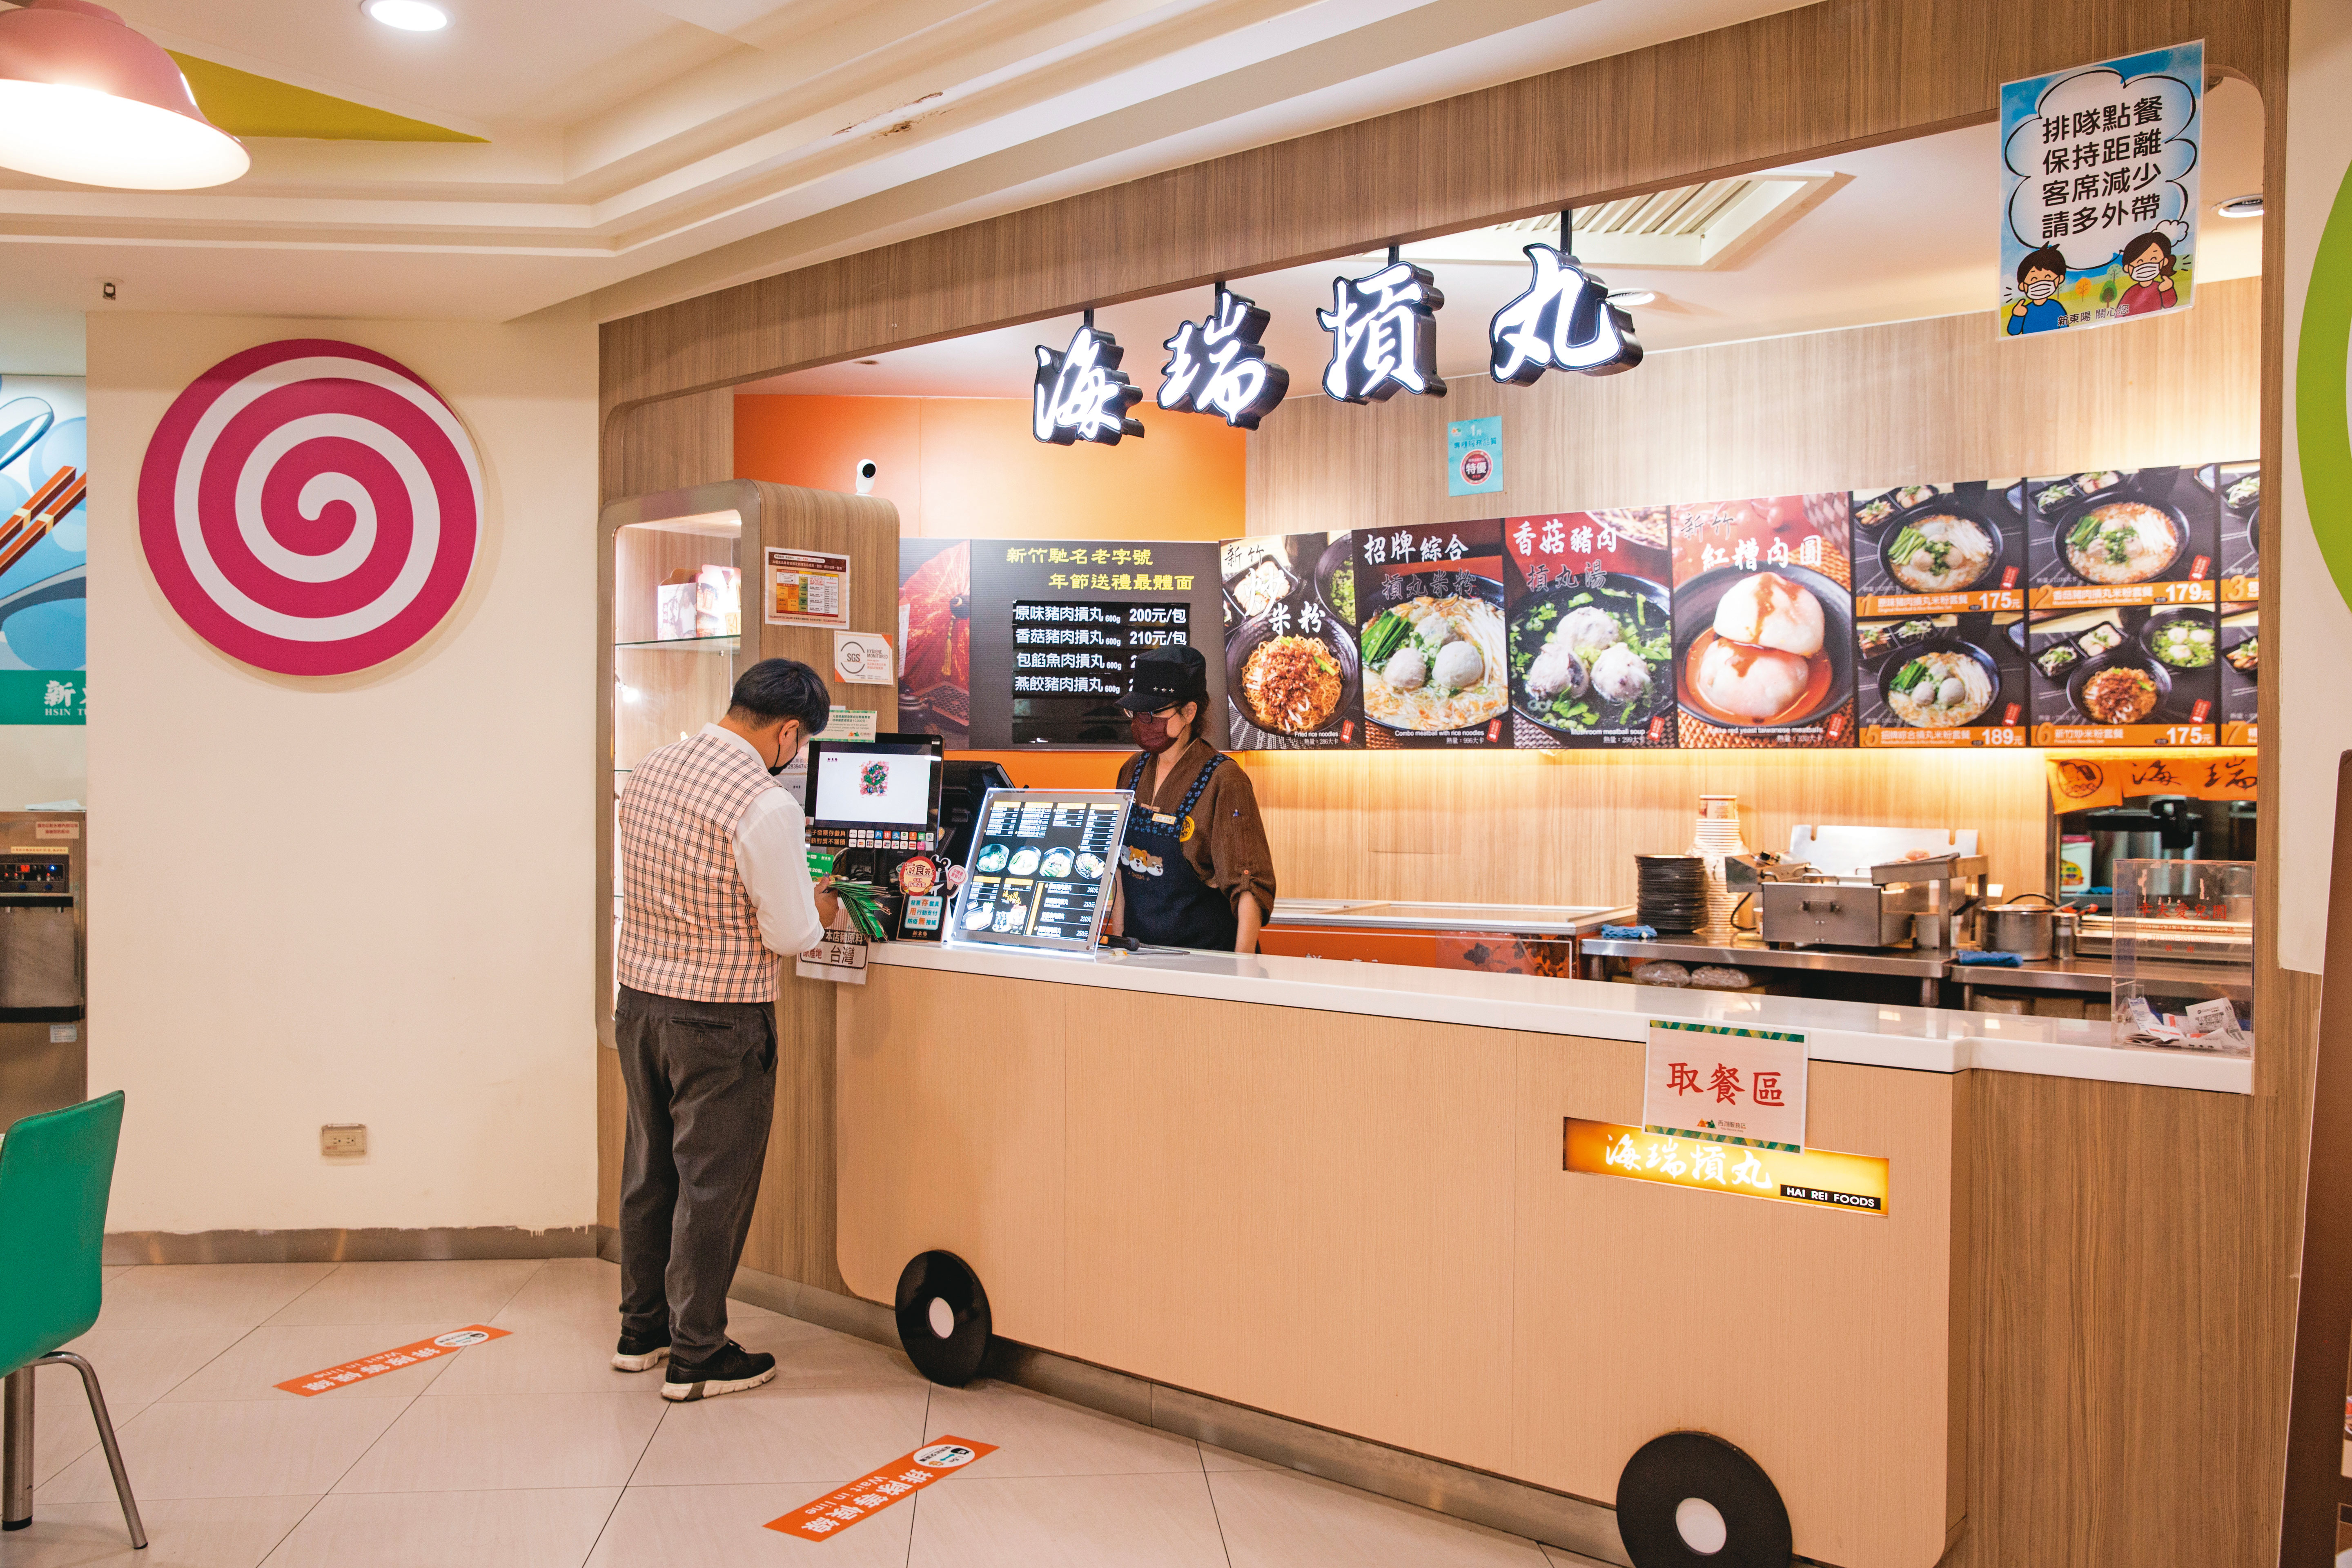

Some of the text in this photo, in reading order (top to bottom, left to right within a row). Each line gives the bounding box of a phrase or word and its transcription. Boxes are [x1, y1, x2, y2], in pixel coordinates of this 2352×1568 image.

[2042, 96, 2163, 144] 排隊點餐
[2042, 128, 2162, 175] 保持距離
[2042, 162, 2161, 207] 客席減少
[2042, 194, 2160, 239] 請多外帶
[2057, 304, 2129, 327] 新東陽 關心您
[1466, 462, 1487, 474] 特優
[1513, 519, 1617, 557] 香菇豬肉
[1681, 512, 1734, 543] 新竹
[1006, 548, 1153, 566] 新竹馳名老字號
[1225, 543, 1264, 569] 新竹
[1363, 530, 1469, 566] 招牌綜合
[1701, 535, 1822, 571] 紅糟肉圓
[1049, 573, 1194, 591] 年節送禮最體面
[2227, 575, 2245, 601] 3
[1860, 593, 1873, 616] 1
[2034, 584, 2053, 609] 2
[2166, 583, 2212, 602] 179元
[1105, 615, 1121, 624] 600g
[1129, 608, 1187, 624] 200元/包
[1105, 637, 1121, 647] 600g
[1129, 630, 1187, 646] 210元/包
[847, 653, 860, 662] SGS
[1106, 662, 1122, 670] 600g
[1105, 685, 1120, 694] 600g
[1864, 724, 1880, 746] 5
[1982, 728, 2022, 745] 189元
[2036, 722, 2053, 745] 6
[2166, 727, 2212, 745] 175元
[2226, 720, 2247, 745] 7
[909, 864, 931, 875] 好食券
[826, 930, 863, 944] 本店豬原料
[831, 945, 855, 964] 台灣
[1666, 1062, 1785, 1107] 取餐區
[1786, 1187, 1875, 1207] HAI REI FOODS
[302, 1347, 441, 1391] 排隊等候線
[366, 1351, 402, 1366] Wait
[314, 1368, 344, 1379] line
[801, 1469, 934, 1533] 排隊等候線
[805, 1475, 888, 1515] Wait in line
